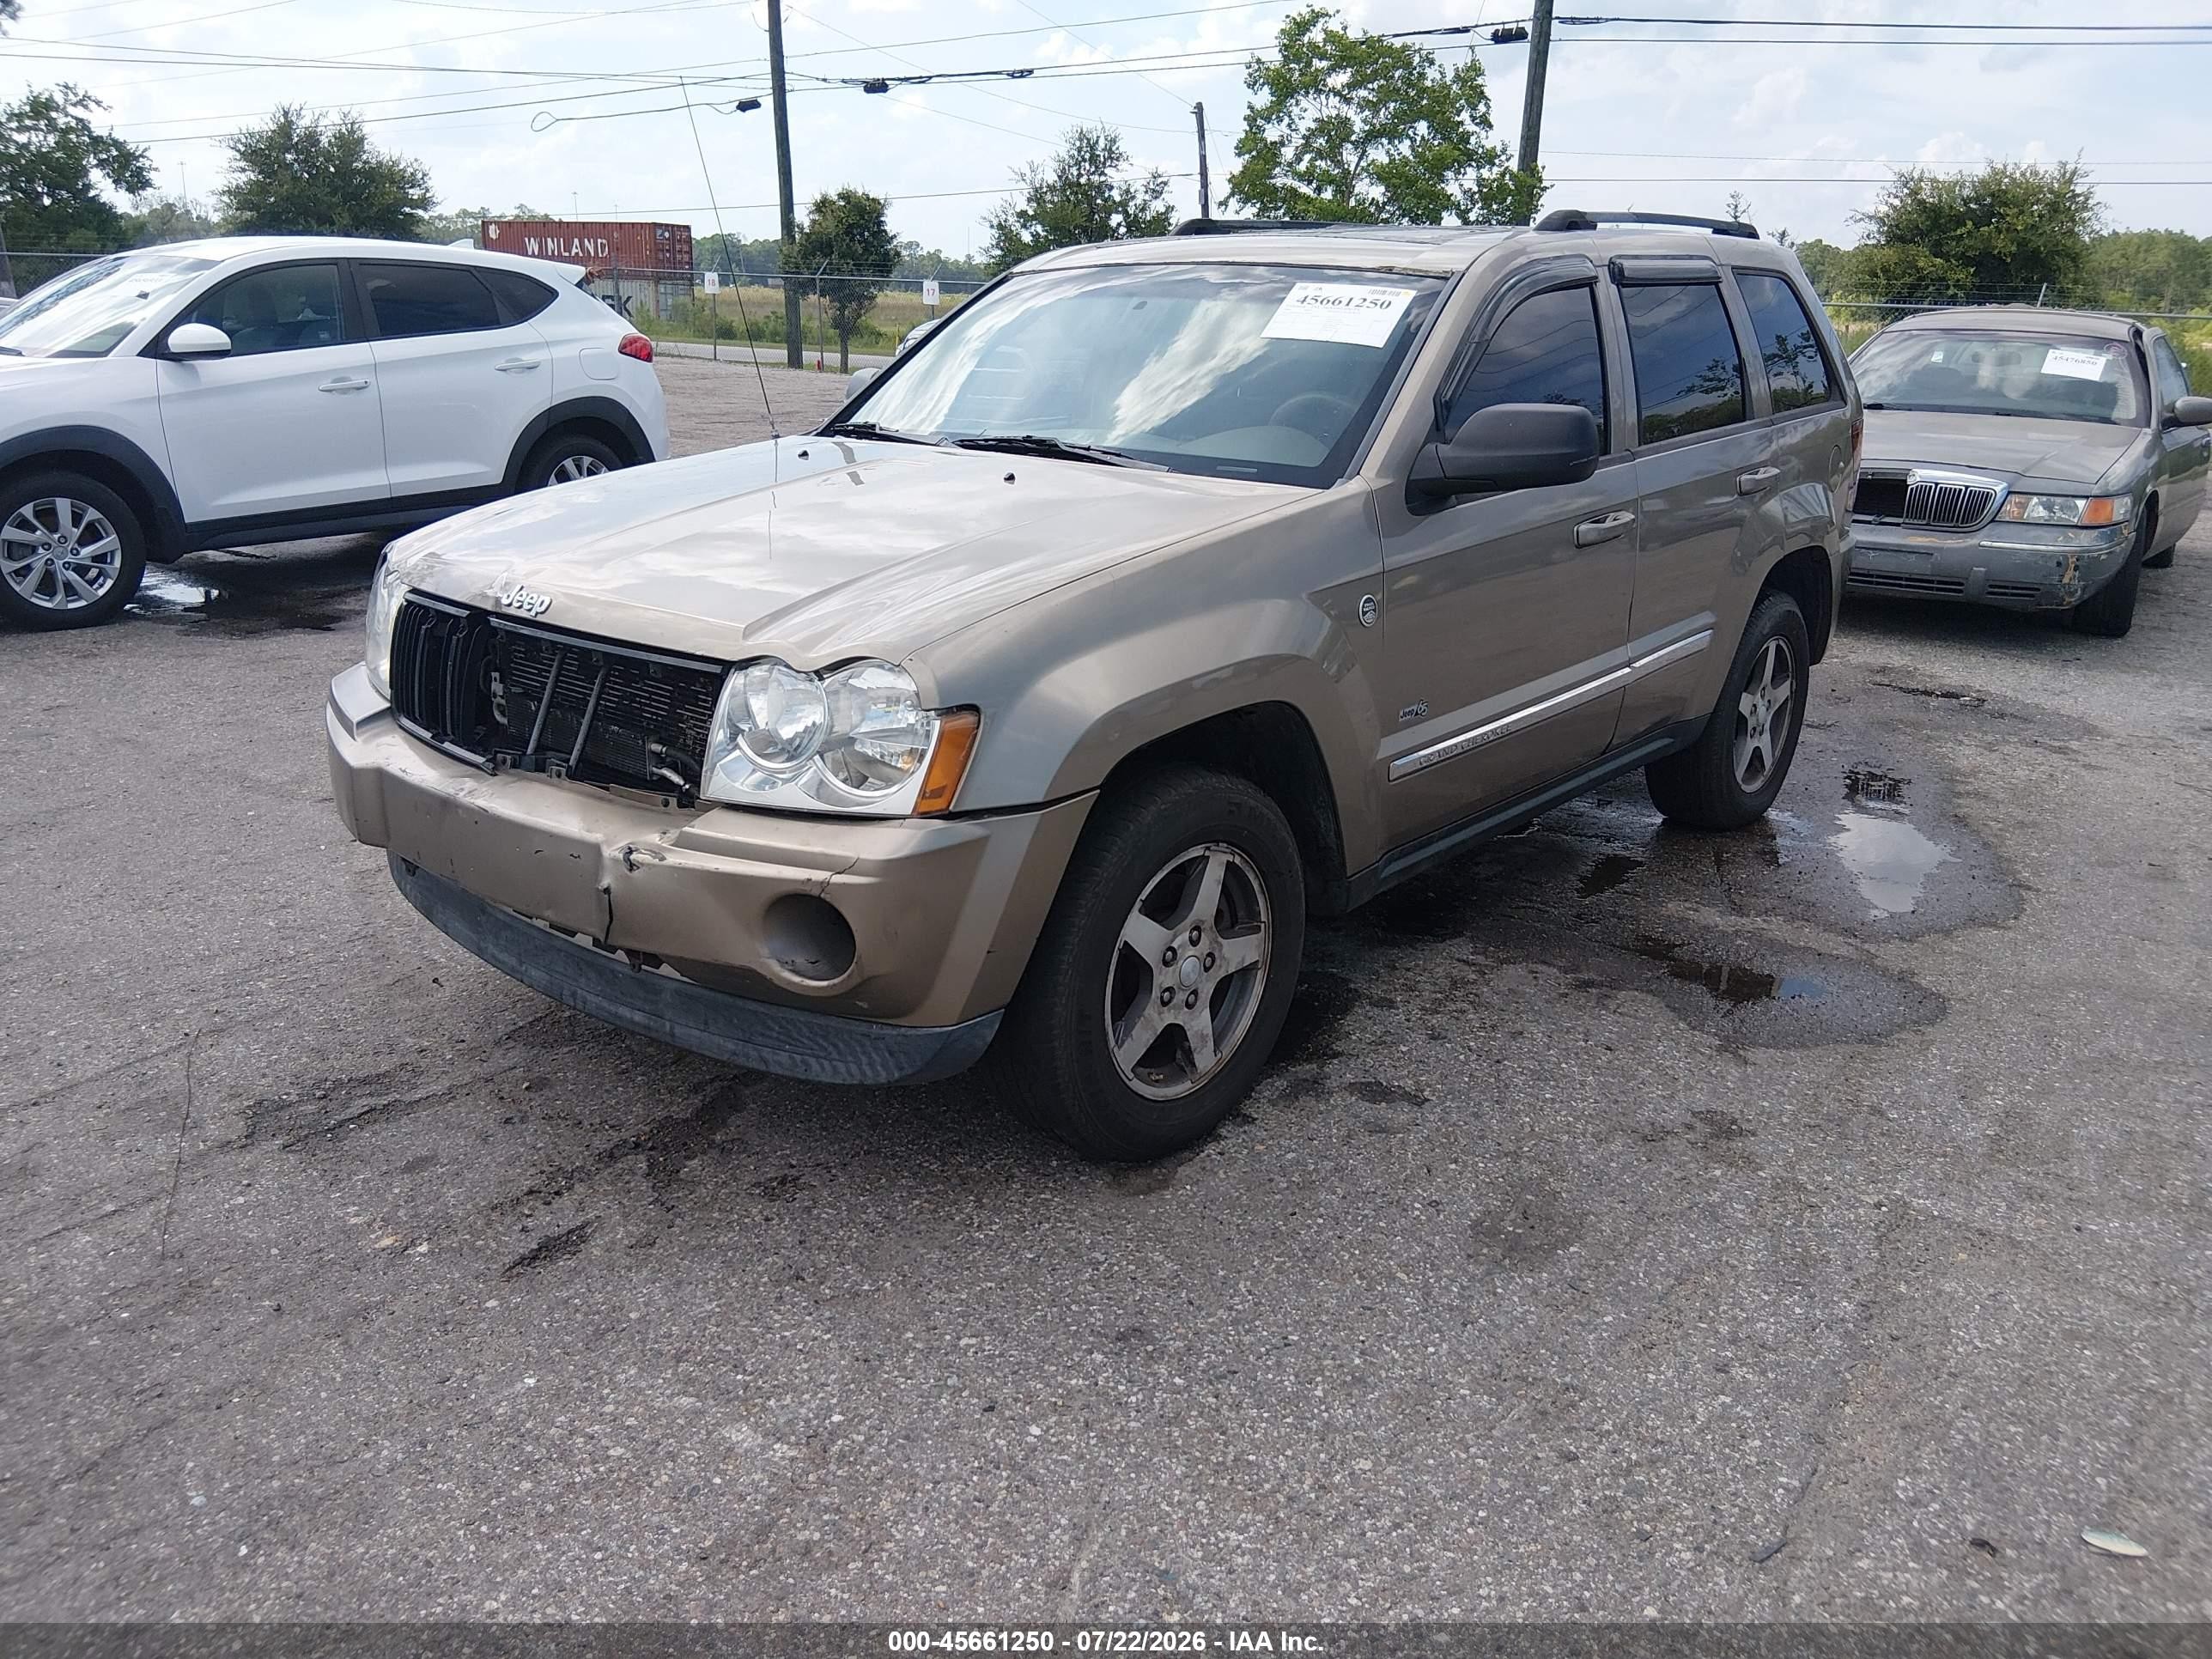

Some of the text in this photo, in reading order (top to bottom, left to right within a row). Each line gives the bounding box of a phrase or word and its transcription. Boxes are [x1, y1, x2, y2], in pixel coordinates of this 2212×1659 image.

[525, 237, 609, 258] WINLAND
[1297, 295, 1392, 310] 45661250
[501, 585, 552, 618] Jeep
[1419, 744, 1457, 765] GRAND
